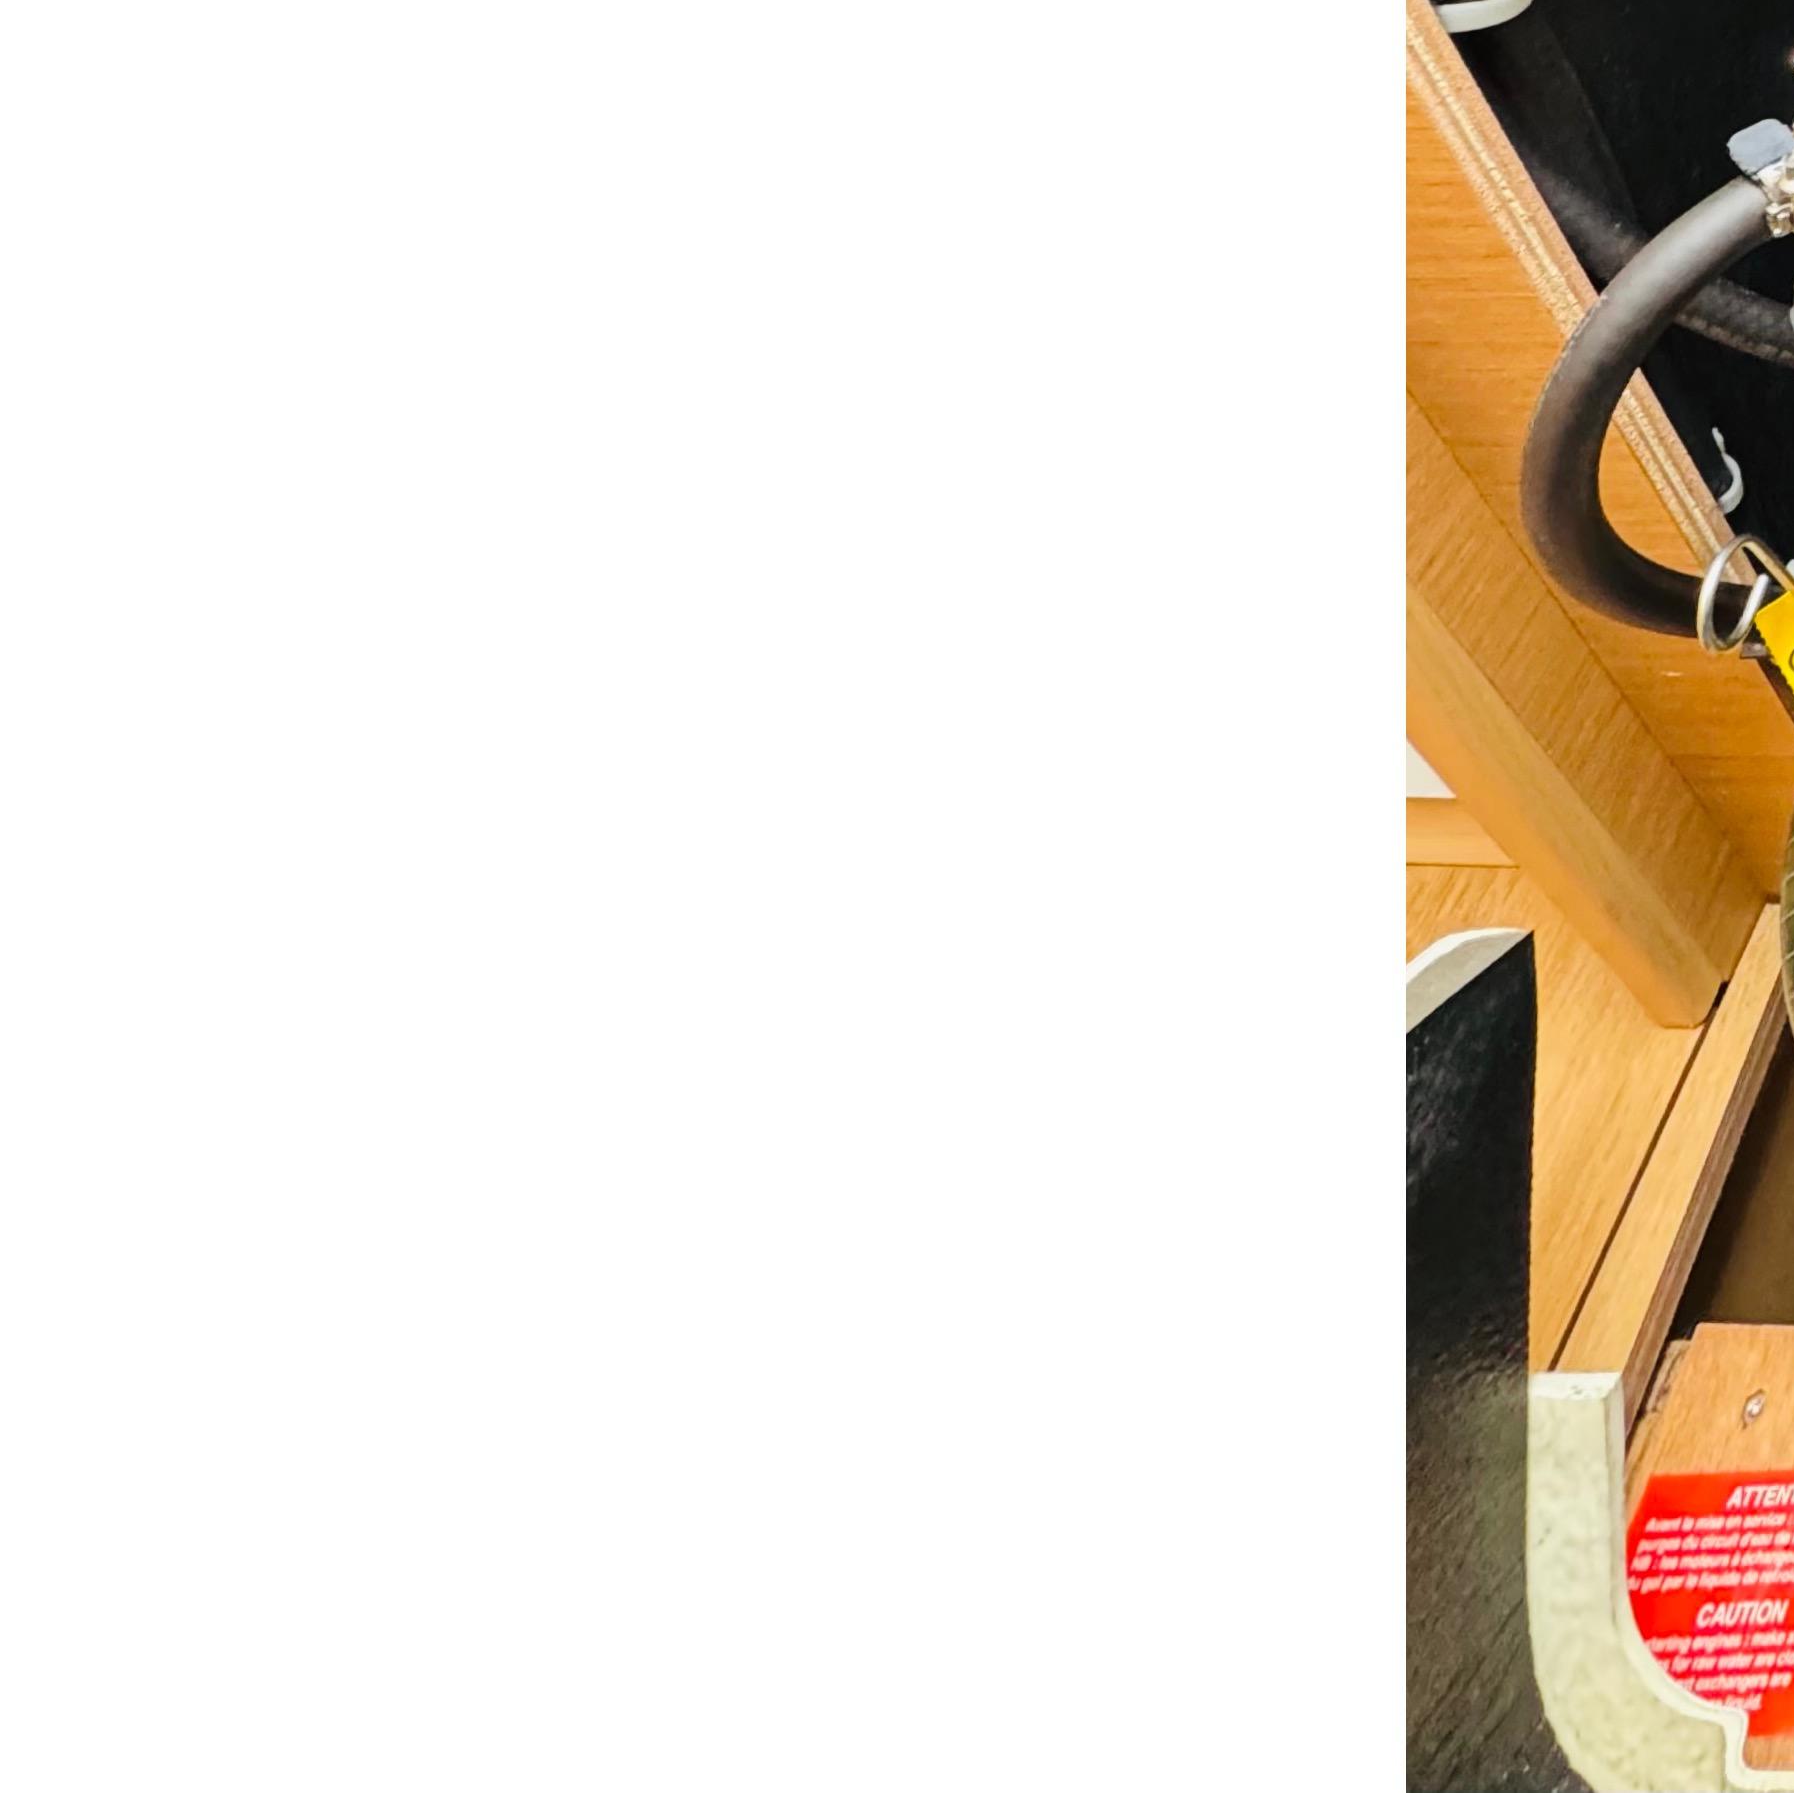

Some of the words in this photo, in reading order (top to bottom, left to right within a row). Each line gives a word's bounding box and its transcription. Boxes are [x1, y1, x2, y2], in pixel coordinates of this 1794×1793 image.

[1696, 1598, 1791, 1628] CAUTION
[1751, 1631, 1786, 1647] make
[1717, 1652, 1754, 1670] water
[1754, 1651, 1776, 1668] are
[1694, 1671, 1770, 1694] exchangers
[1769, 1669, 1794, 1688] are
